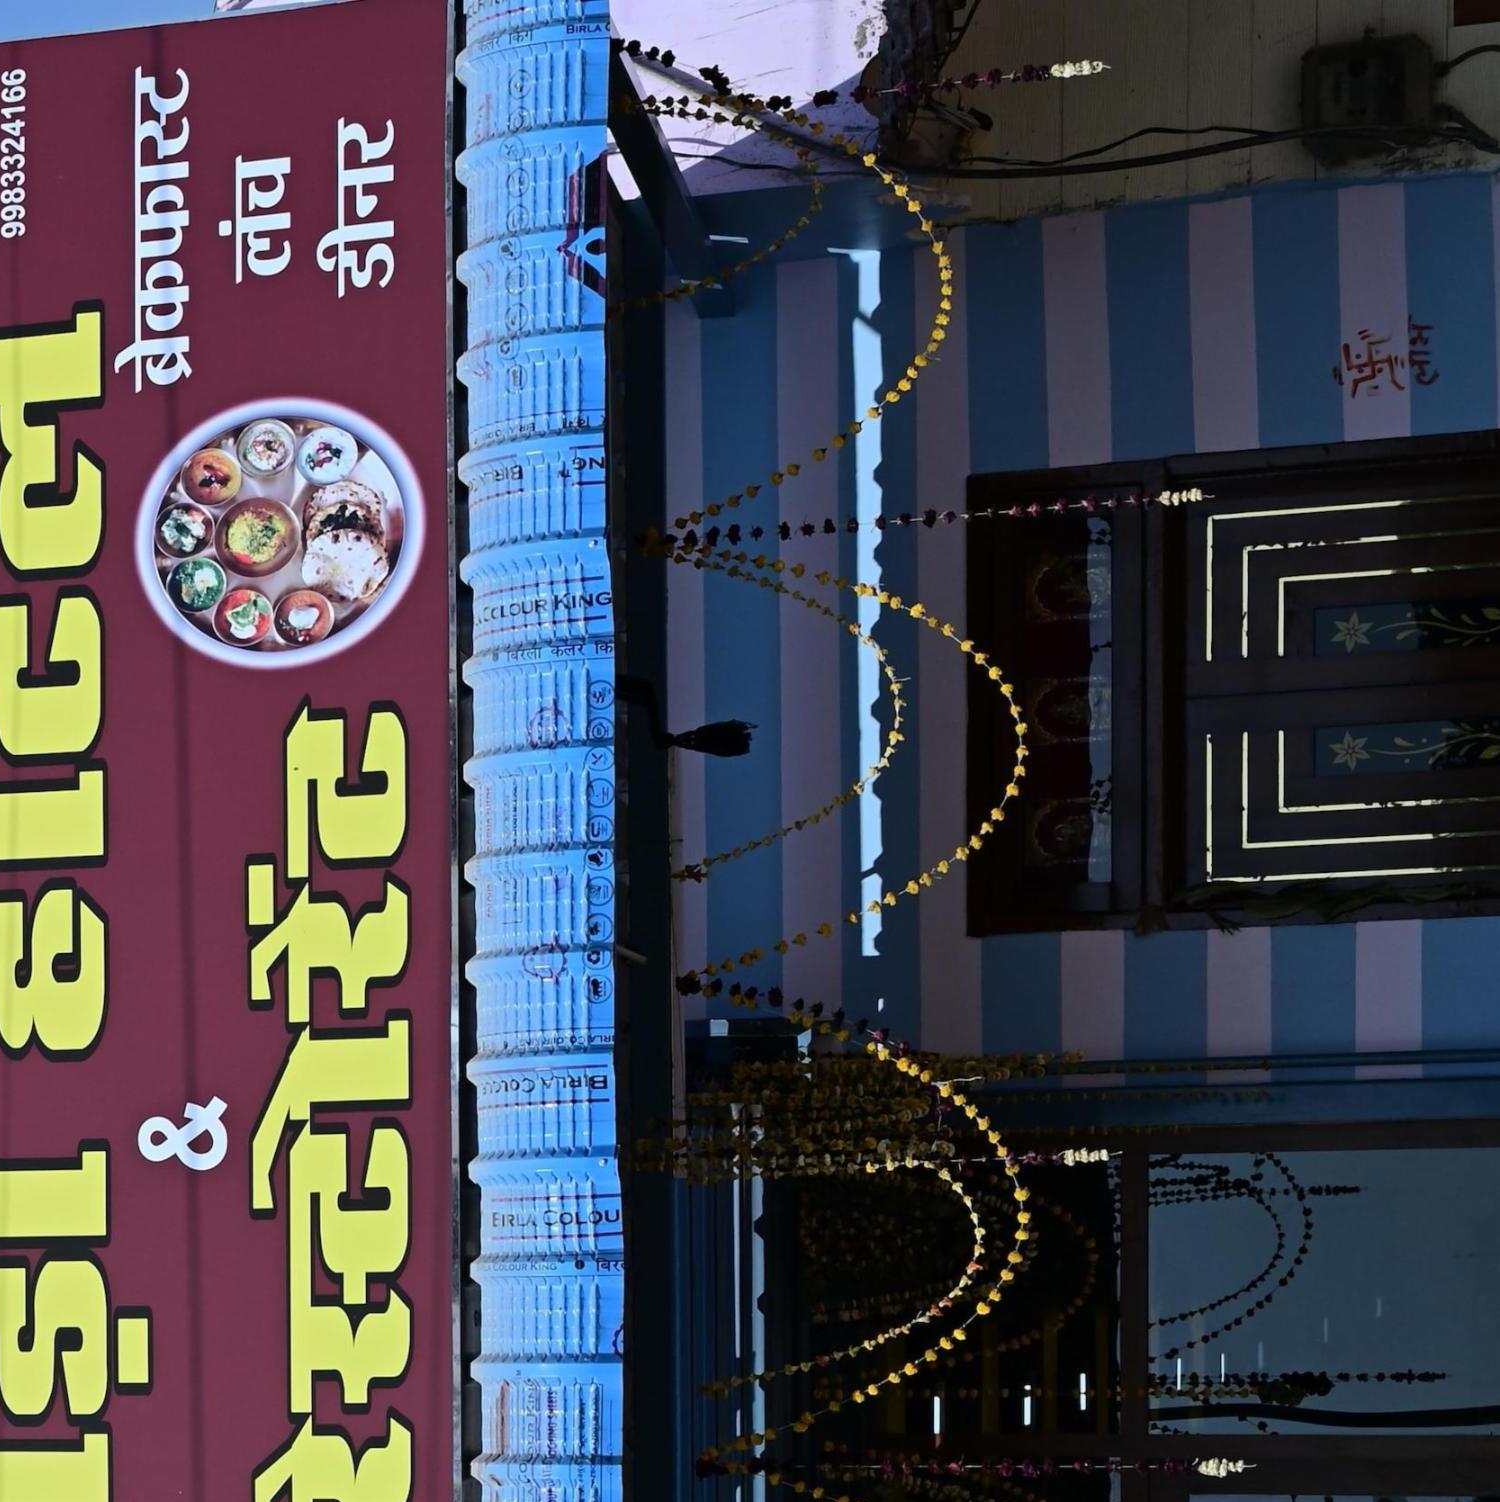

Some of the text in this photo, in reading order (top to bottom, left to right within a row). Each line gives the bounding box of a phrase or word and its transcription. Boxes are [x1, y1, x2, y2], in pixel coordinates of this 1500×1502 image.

[0, 68, 28, 238] 9983324166
[115, 66, 192, 393] ब्रेकफास्ट
[218, 155, 292, 284] लंच
[317, 116, 397, 297] डीनर
[552, 591, 613, 612] KING
[540, 1074, 609, 1091] BIRLA
[137, 1097, 229, 1170] &
[542, 1208, 620, 1225] COLOU
